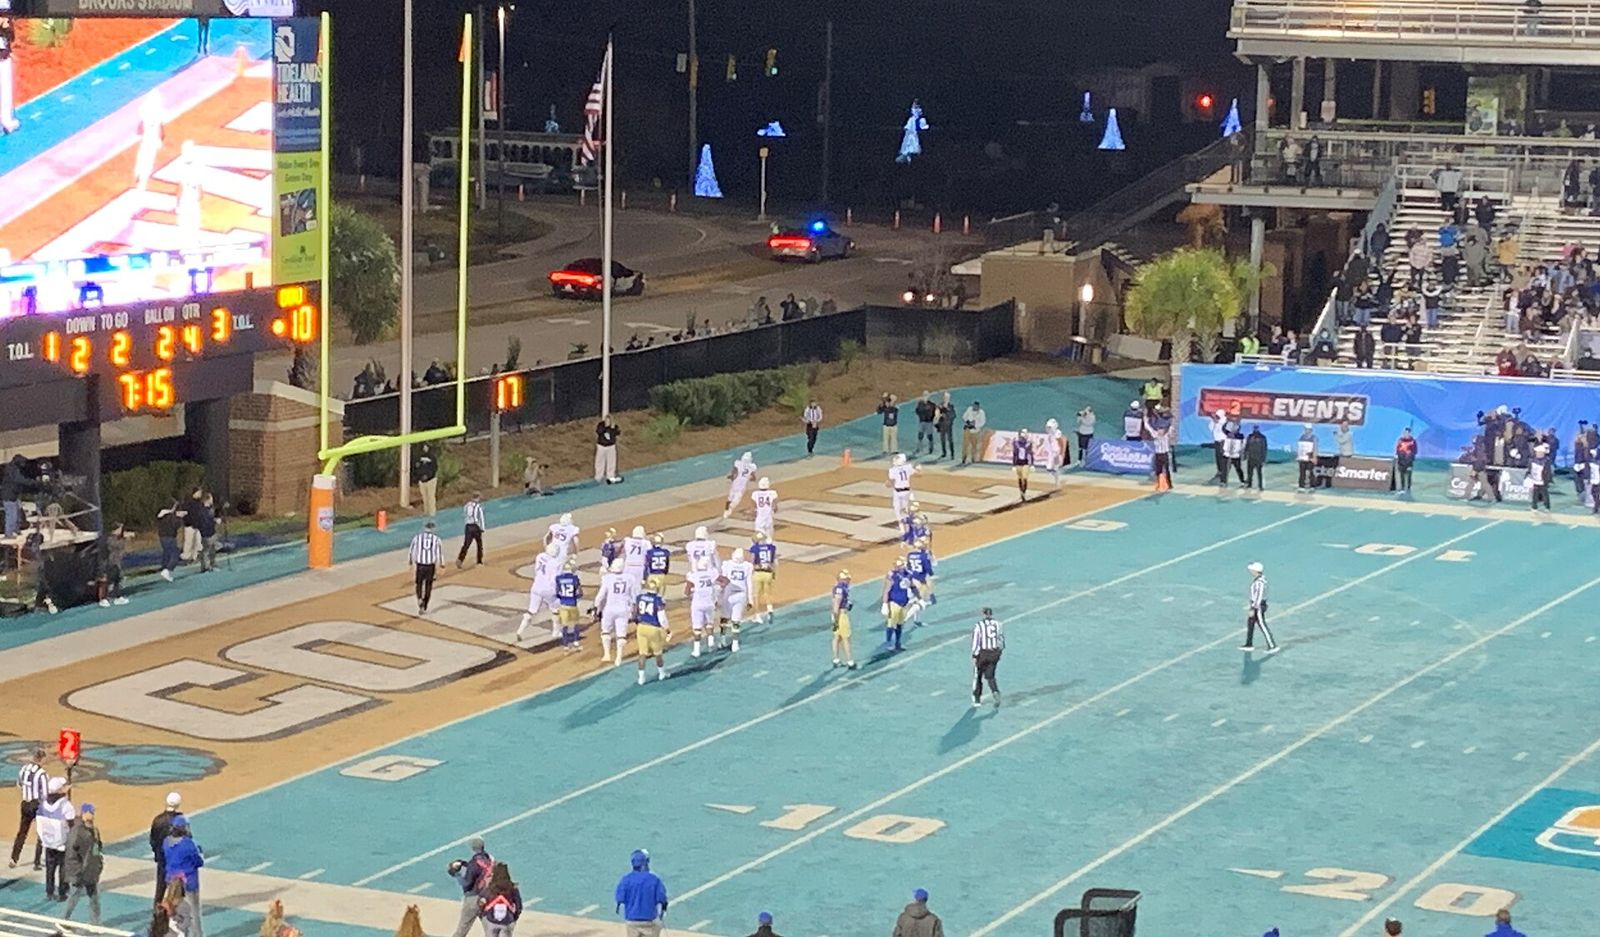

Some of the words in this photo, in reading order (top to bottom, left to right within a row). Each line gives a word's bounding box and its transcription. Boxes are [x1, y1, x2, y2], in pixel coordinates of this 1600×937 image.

[277, 83, 312, 103] HEALTH
[101, 313, 112, 330] TO
[114, 311, 128, 329] GO
[145, 308, 162, 324] BALL
[182, 303, 200, 320] QTR
[66, 316, 95, 334] DOWN
[212, 308, 229, 342] 3
[292, 305, 313, 342] 10
[111, 331, 129, 366] 2
[158, 325, 174, 361] 2
[183, 325, 200, 353] 4
[71, 338, 89, 374] 2
[119, 369, 173, 411] 7:15
[497, 376, 519, 409] 17
[1273, 397, 1364, 420] EVENTS
[898, 470, 908, 481] 11
[758, 496, 771, 508] 84
[629, 544, 641, 555] 71
[650, 556, 668, 570] 25
[559, 583, 575, 598] 12
[613, 581, 627, 594] 67
[638, 595, 655, 616] 94
[60, 730, 77, 758] 2
[759, 803, 946, 843] 10
[1280, 866, 1519, 917] 20
